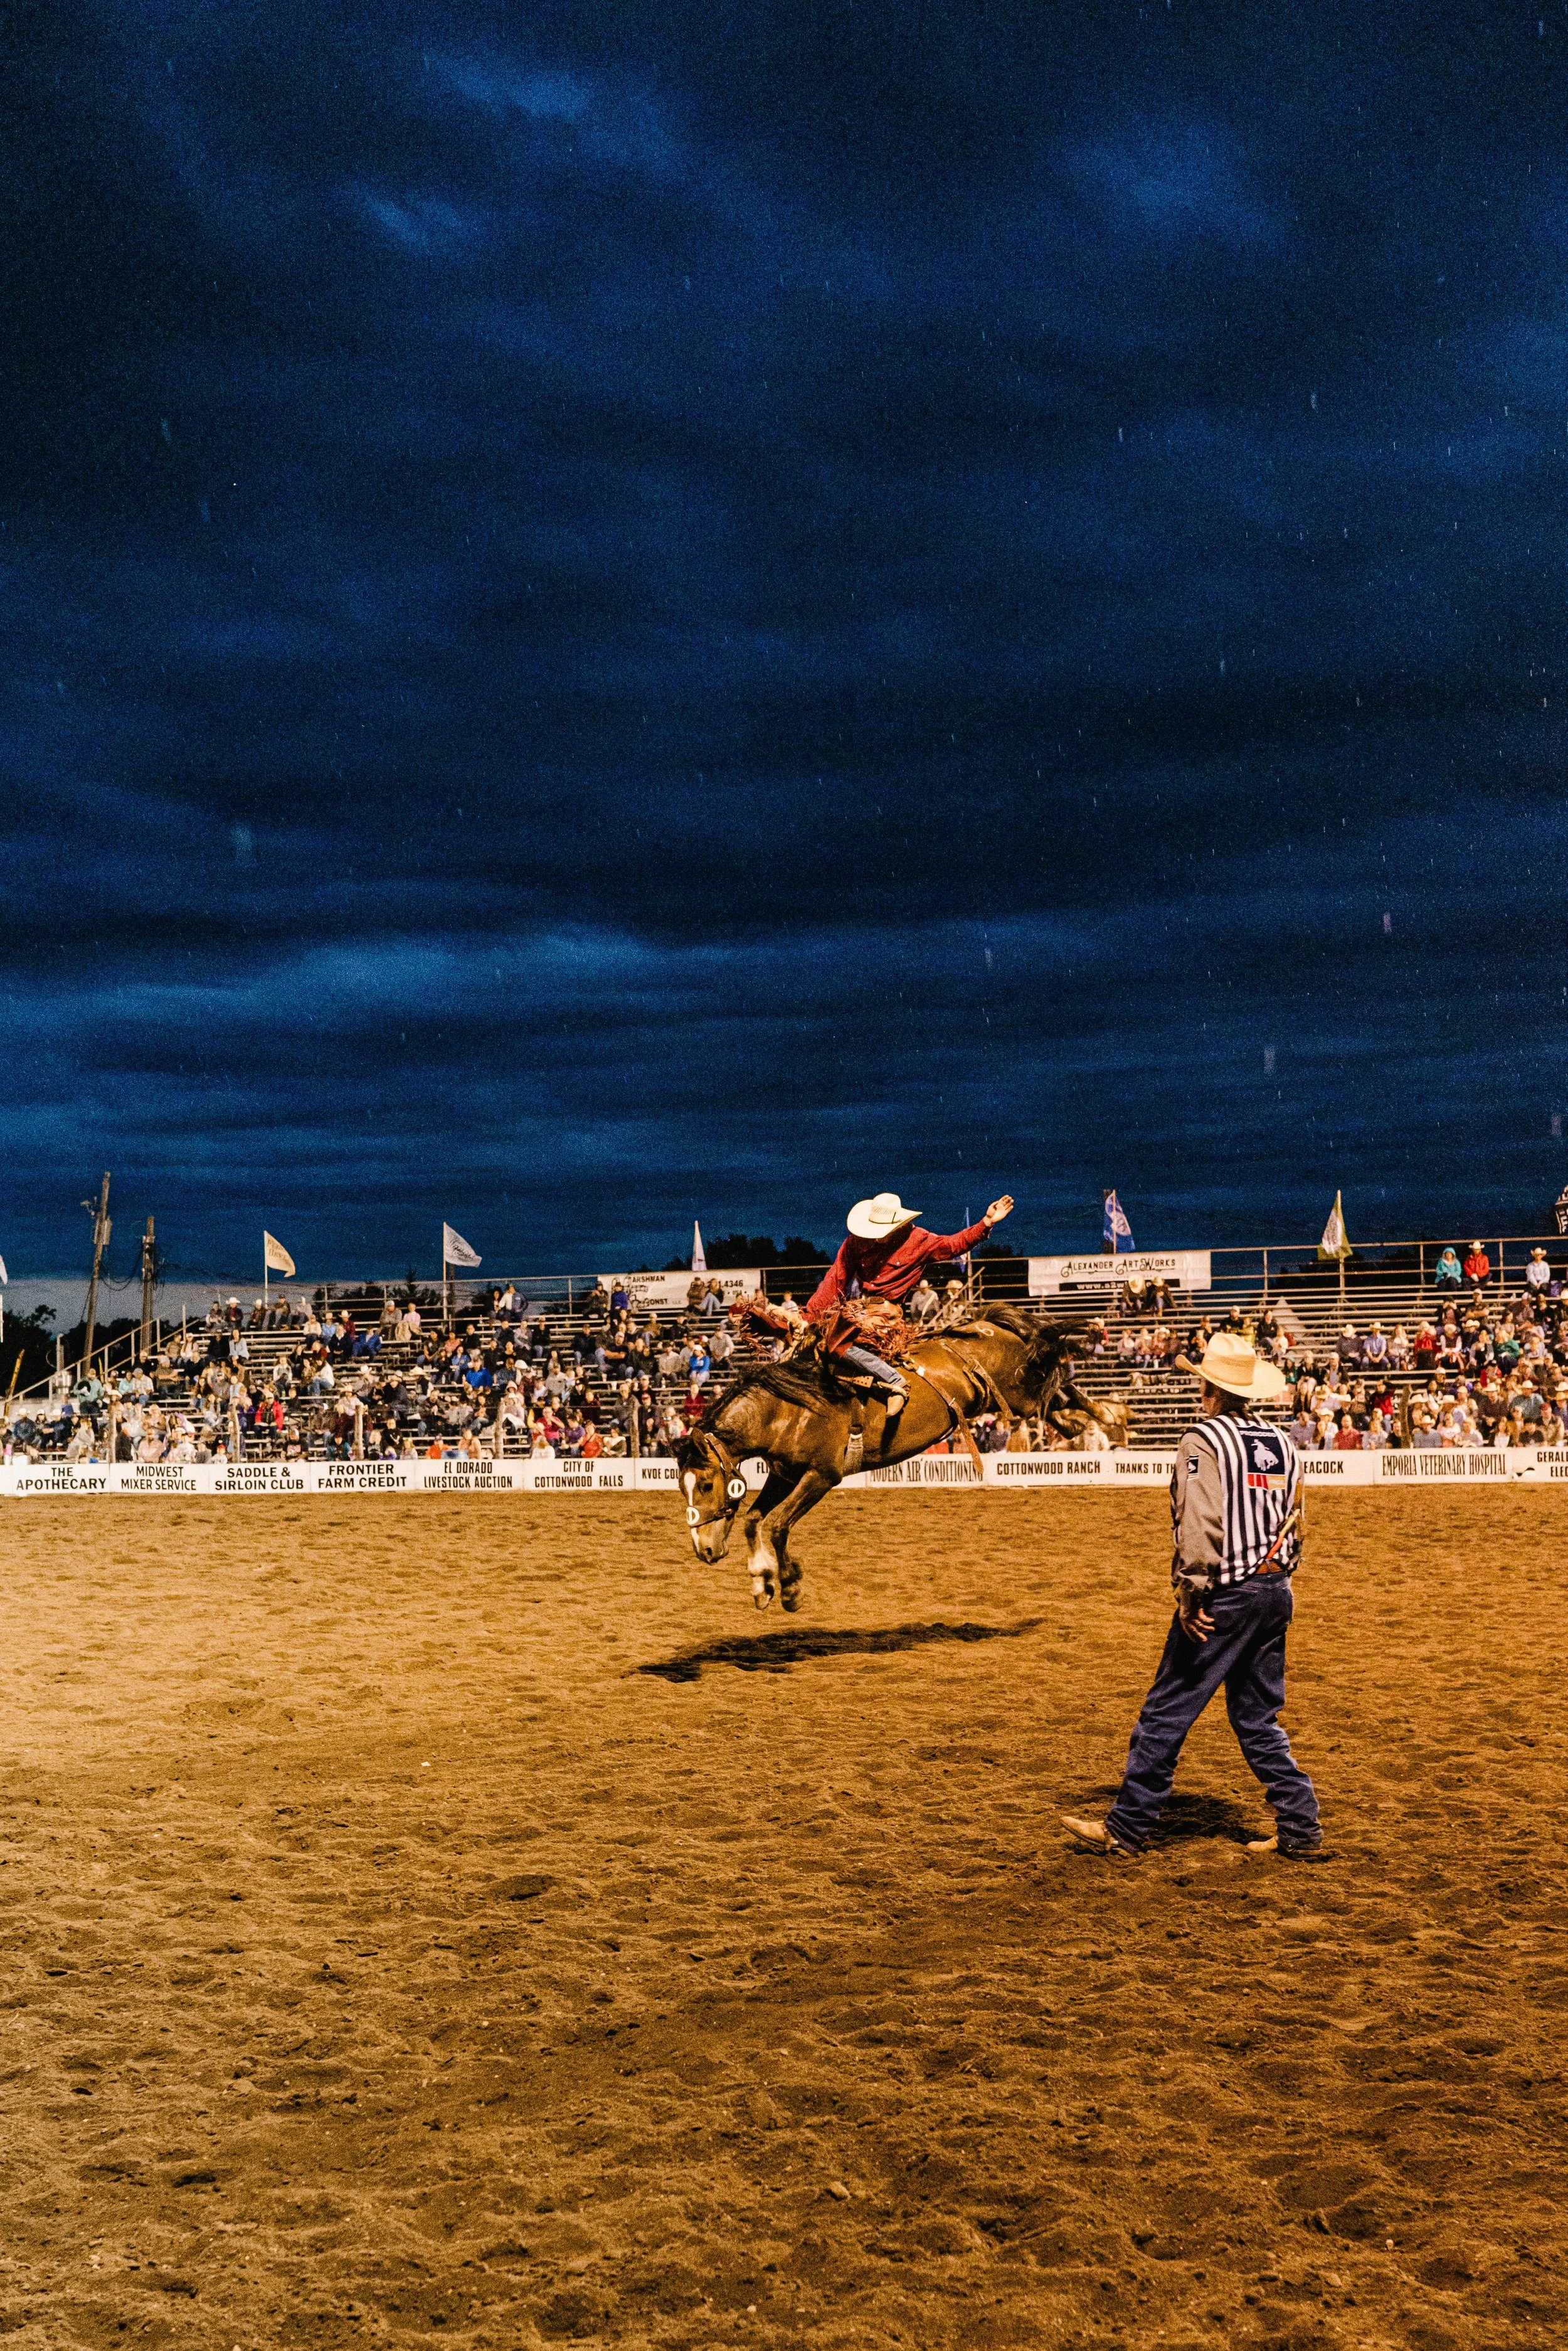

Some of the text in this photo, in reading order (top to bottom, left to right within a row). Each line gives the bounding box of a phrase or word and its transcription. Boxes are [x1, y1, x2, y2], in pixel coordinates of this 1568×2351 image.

[1061, 1261, 1113, 1278] ALEXANDER
[329, 1464, 394, 1475] FRONTIER
[444, 1462, 492, 1473] EL DORADO
[563, 1461, 595, 1472] CITY OF
[757, 1462, 768, 1473] FLI
[997, 1461, 1100, 1475] COTTONWOOD RANCH
[1115, 1463, 1176, 1473] THANKS TO TH
[1304, 1461, 1343, 1473] EACOCK
[1382, 1453, 1507, 1476] EMPORIA VETERINARY HOSPITAL
[51, 1467, 73, 1477] THE
[136, 1466, 184, 1477] MIDWEST
[227, 1467, 290, 1478] SADDLE &
[642, 1468, 680, 1479] KVOE COU
[907, 1461, 921, 1482] AIR
[16, 1478, 107, 1490] APOTHECARY
[121, 1478, 196, 1490] MIXER SERVICE
[215, 1479, 304, 1490] SIRLOIN CLUB
[318, 1477, 407, 1489] FARM CREDIT
[424, 1476, 512, 1488] LIVESTOCK AUCTION
[534, 1475, 623, 1487] COTTONWOOD FALLS
